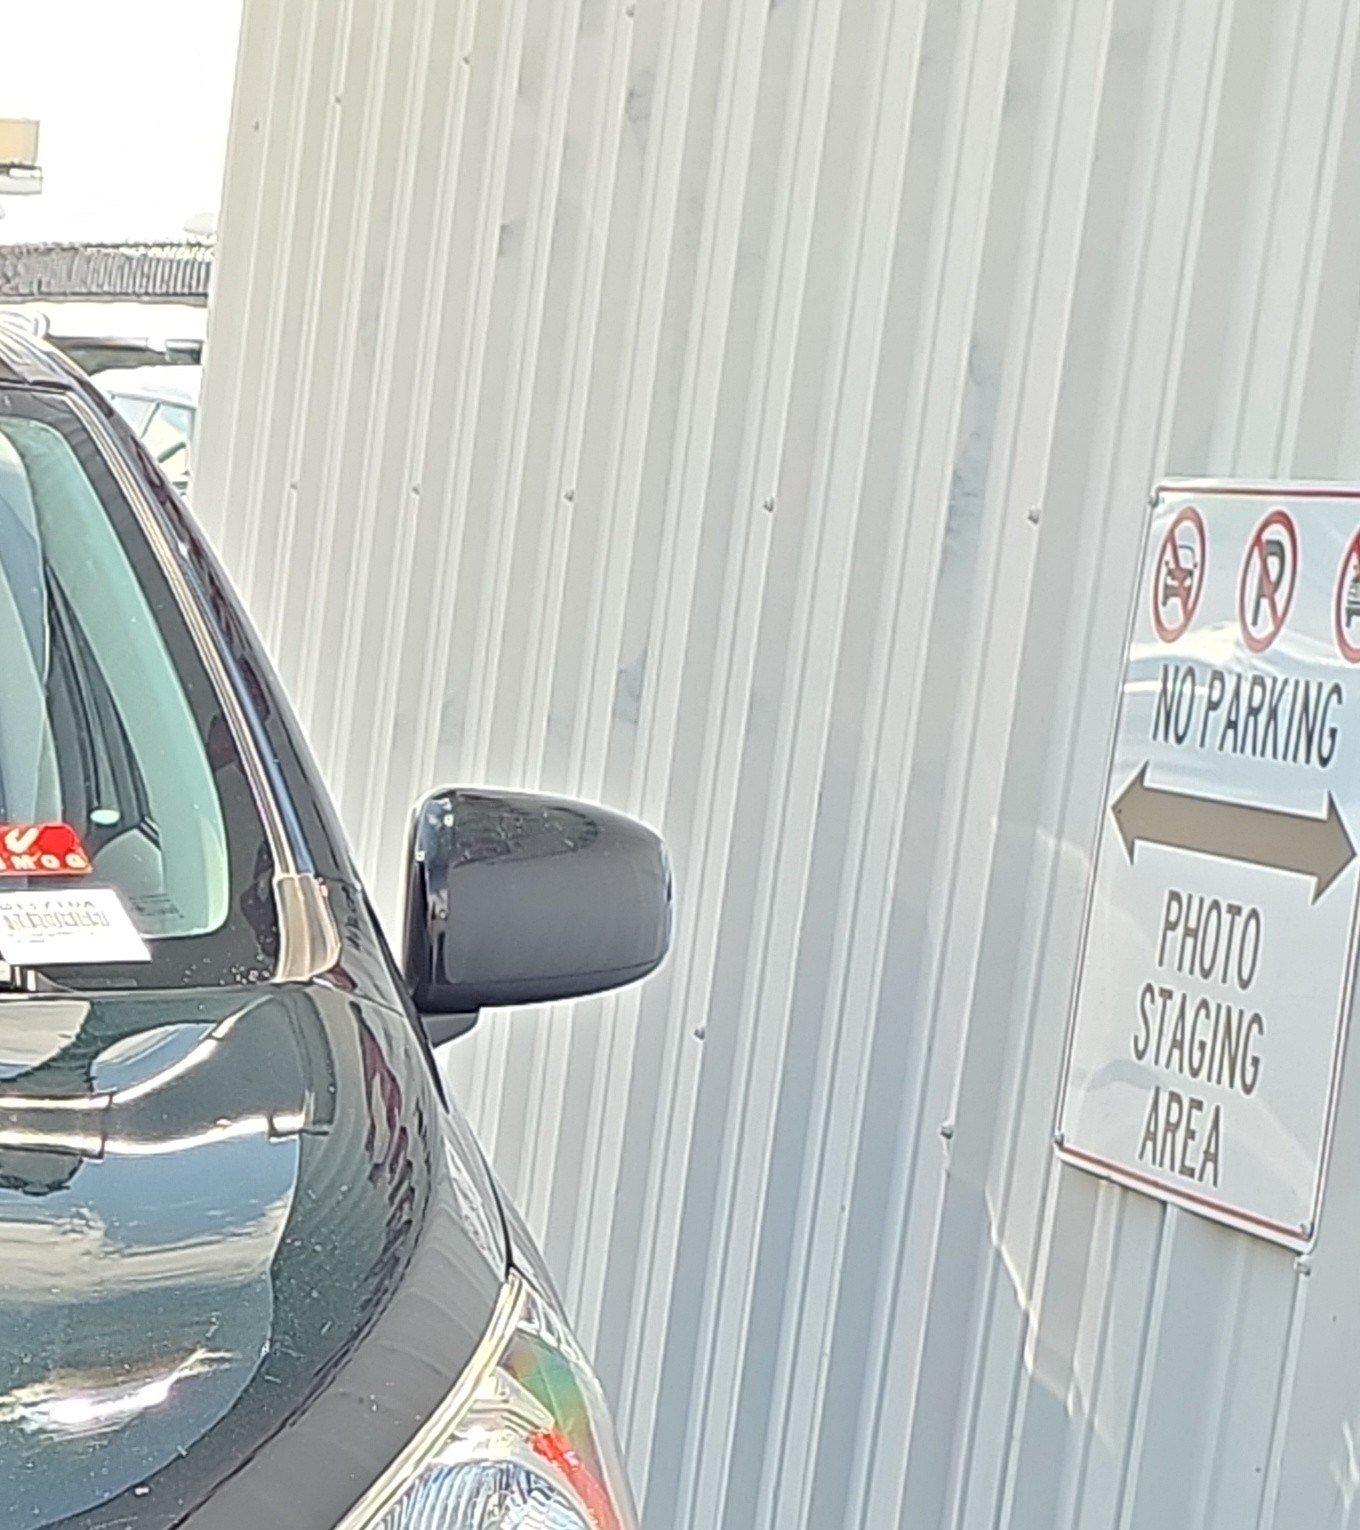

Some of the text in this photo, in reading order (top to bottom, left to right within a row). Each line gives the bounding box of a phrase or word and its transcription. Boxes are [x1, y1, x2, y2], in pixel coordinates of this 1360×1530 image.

[1251, 539, 1286, 627] P
[1152, 663, 1344, 768] NO PARKING
[1158, 889, 1261, 990] PHOTO
[1133, 982, 1264, 1095] STAGING
[1138, 1085, 1220, 1188] AREA
